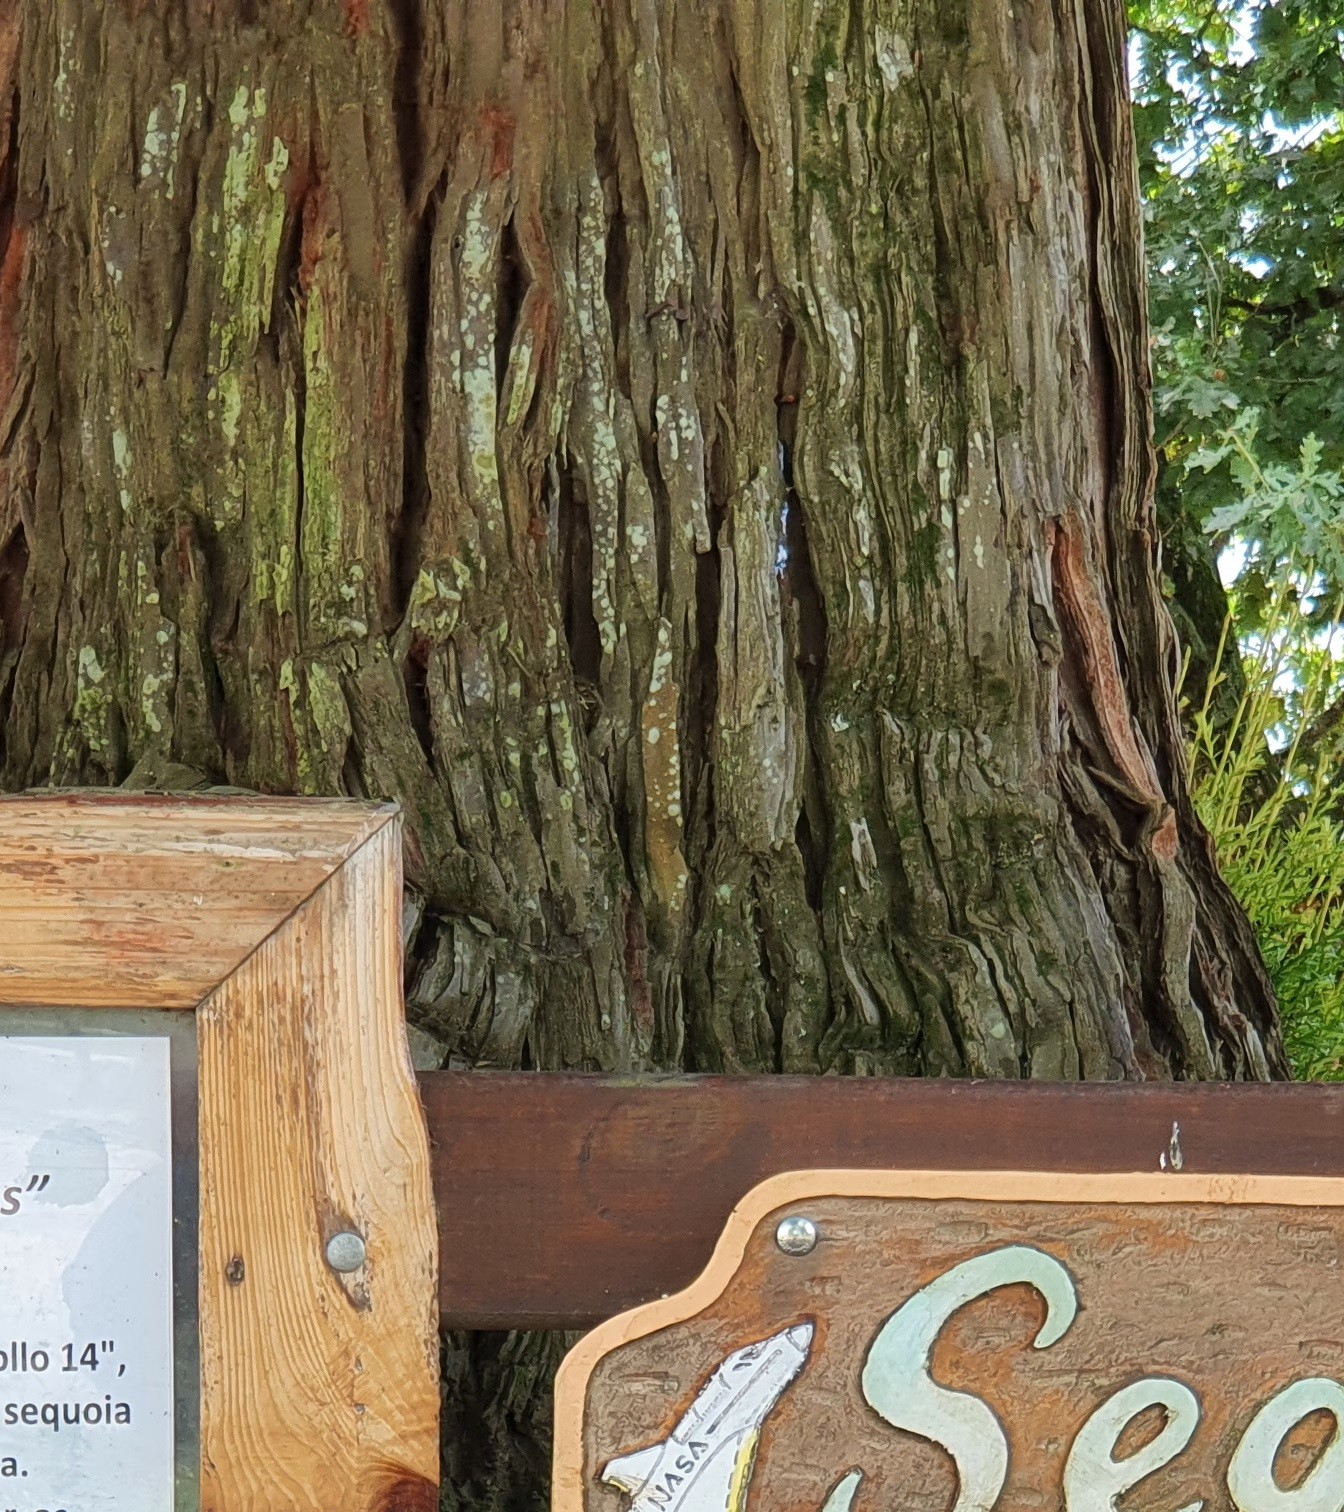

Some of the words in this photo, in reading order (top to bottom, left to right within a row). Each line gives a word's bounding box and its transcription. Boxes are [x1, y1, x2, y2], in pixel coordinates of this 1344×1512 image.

[61, 1340, 126, 1378] 14",
[4, 1394, 131, 1433] sequoia
[647, 1440, 709, 1512] NASA
